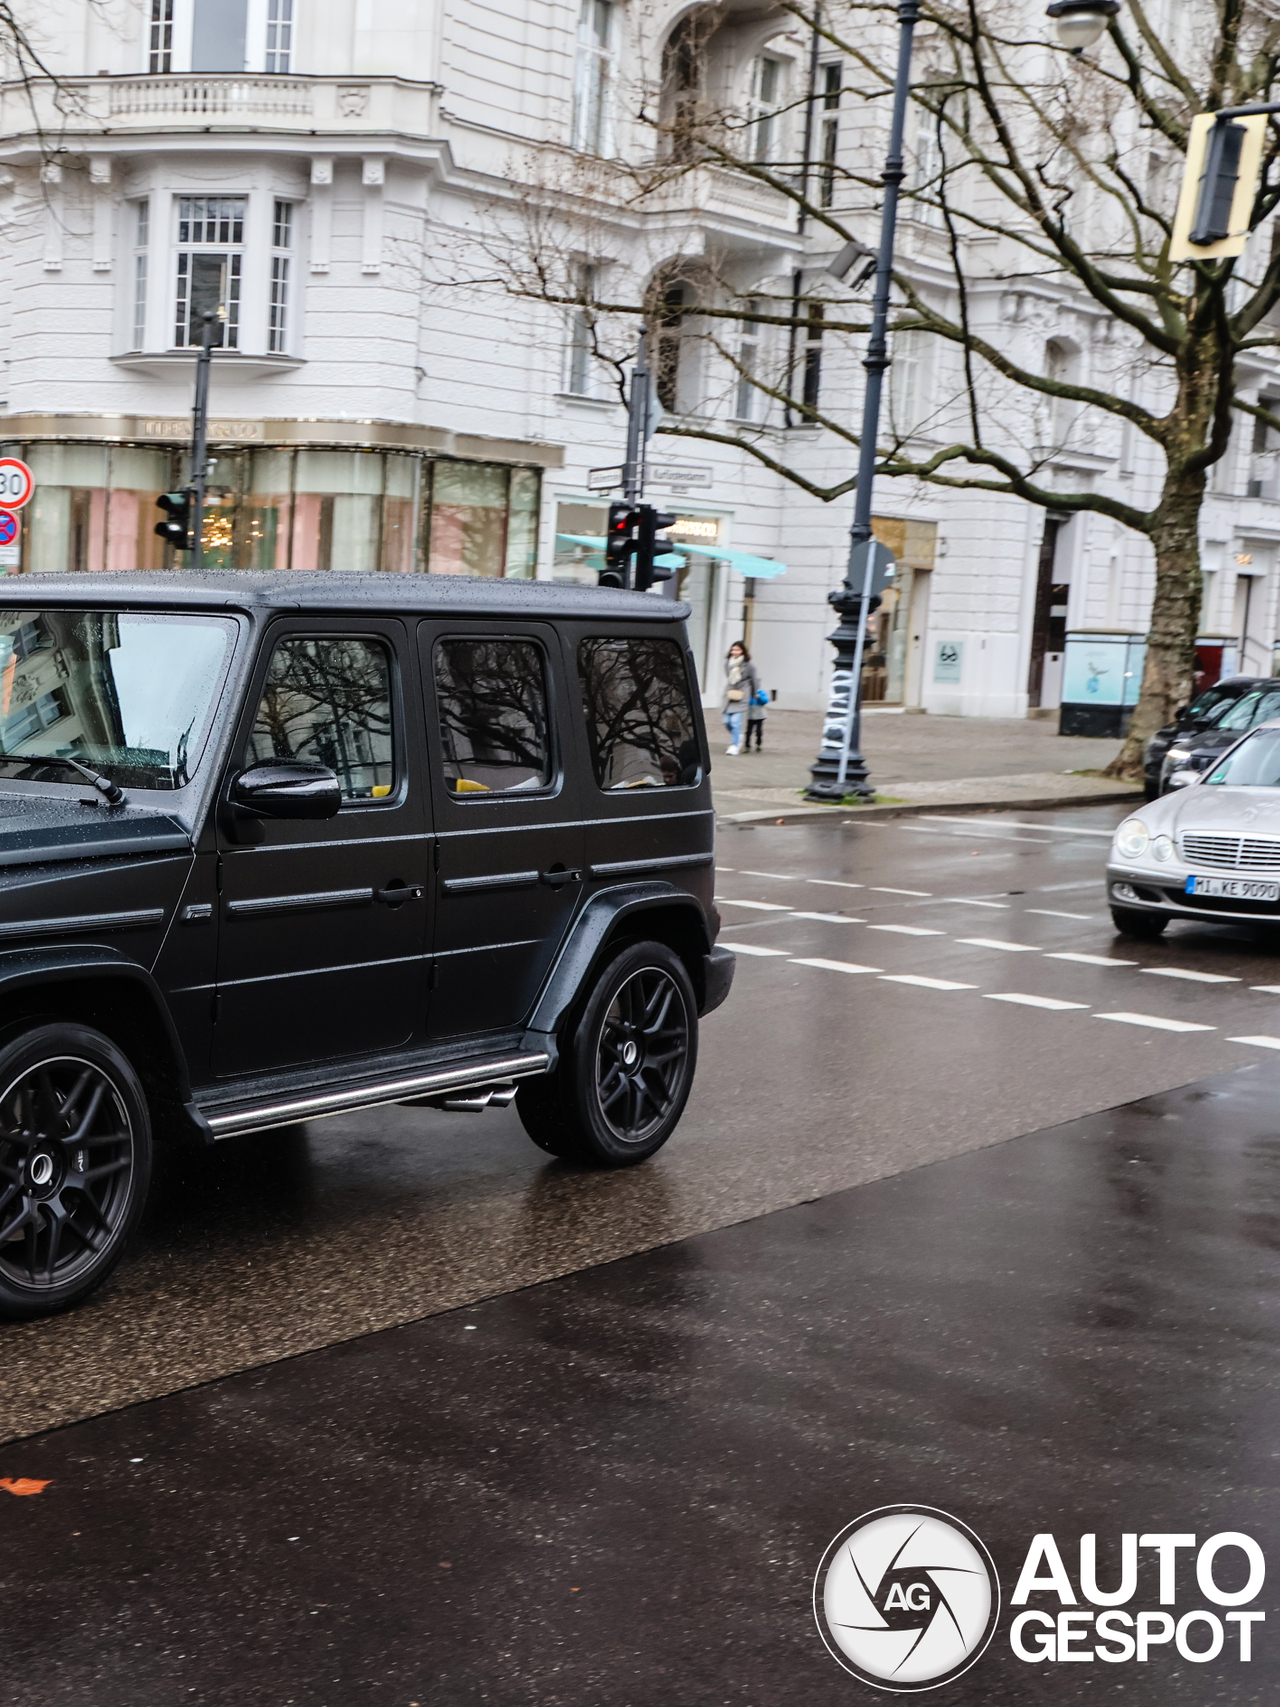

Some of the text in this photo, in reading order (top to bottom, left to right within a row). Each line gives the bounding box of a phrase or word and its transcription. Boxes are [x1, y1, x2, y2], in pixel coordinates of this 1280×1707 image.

[1196, 879, 1276, 898] MI KE 9090
